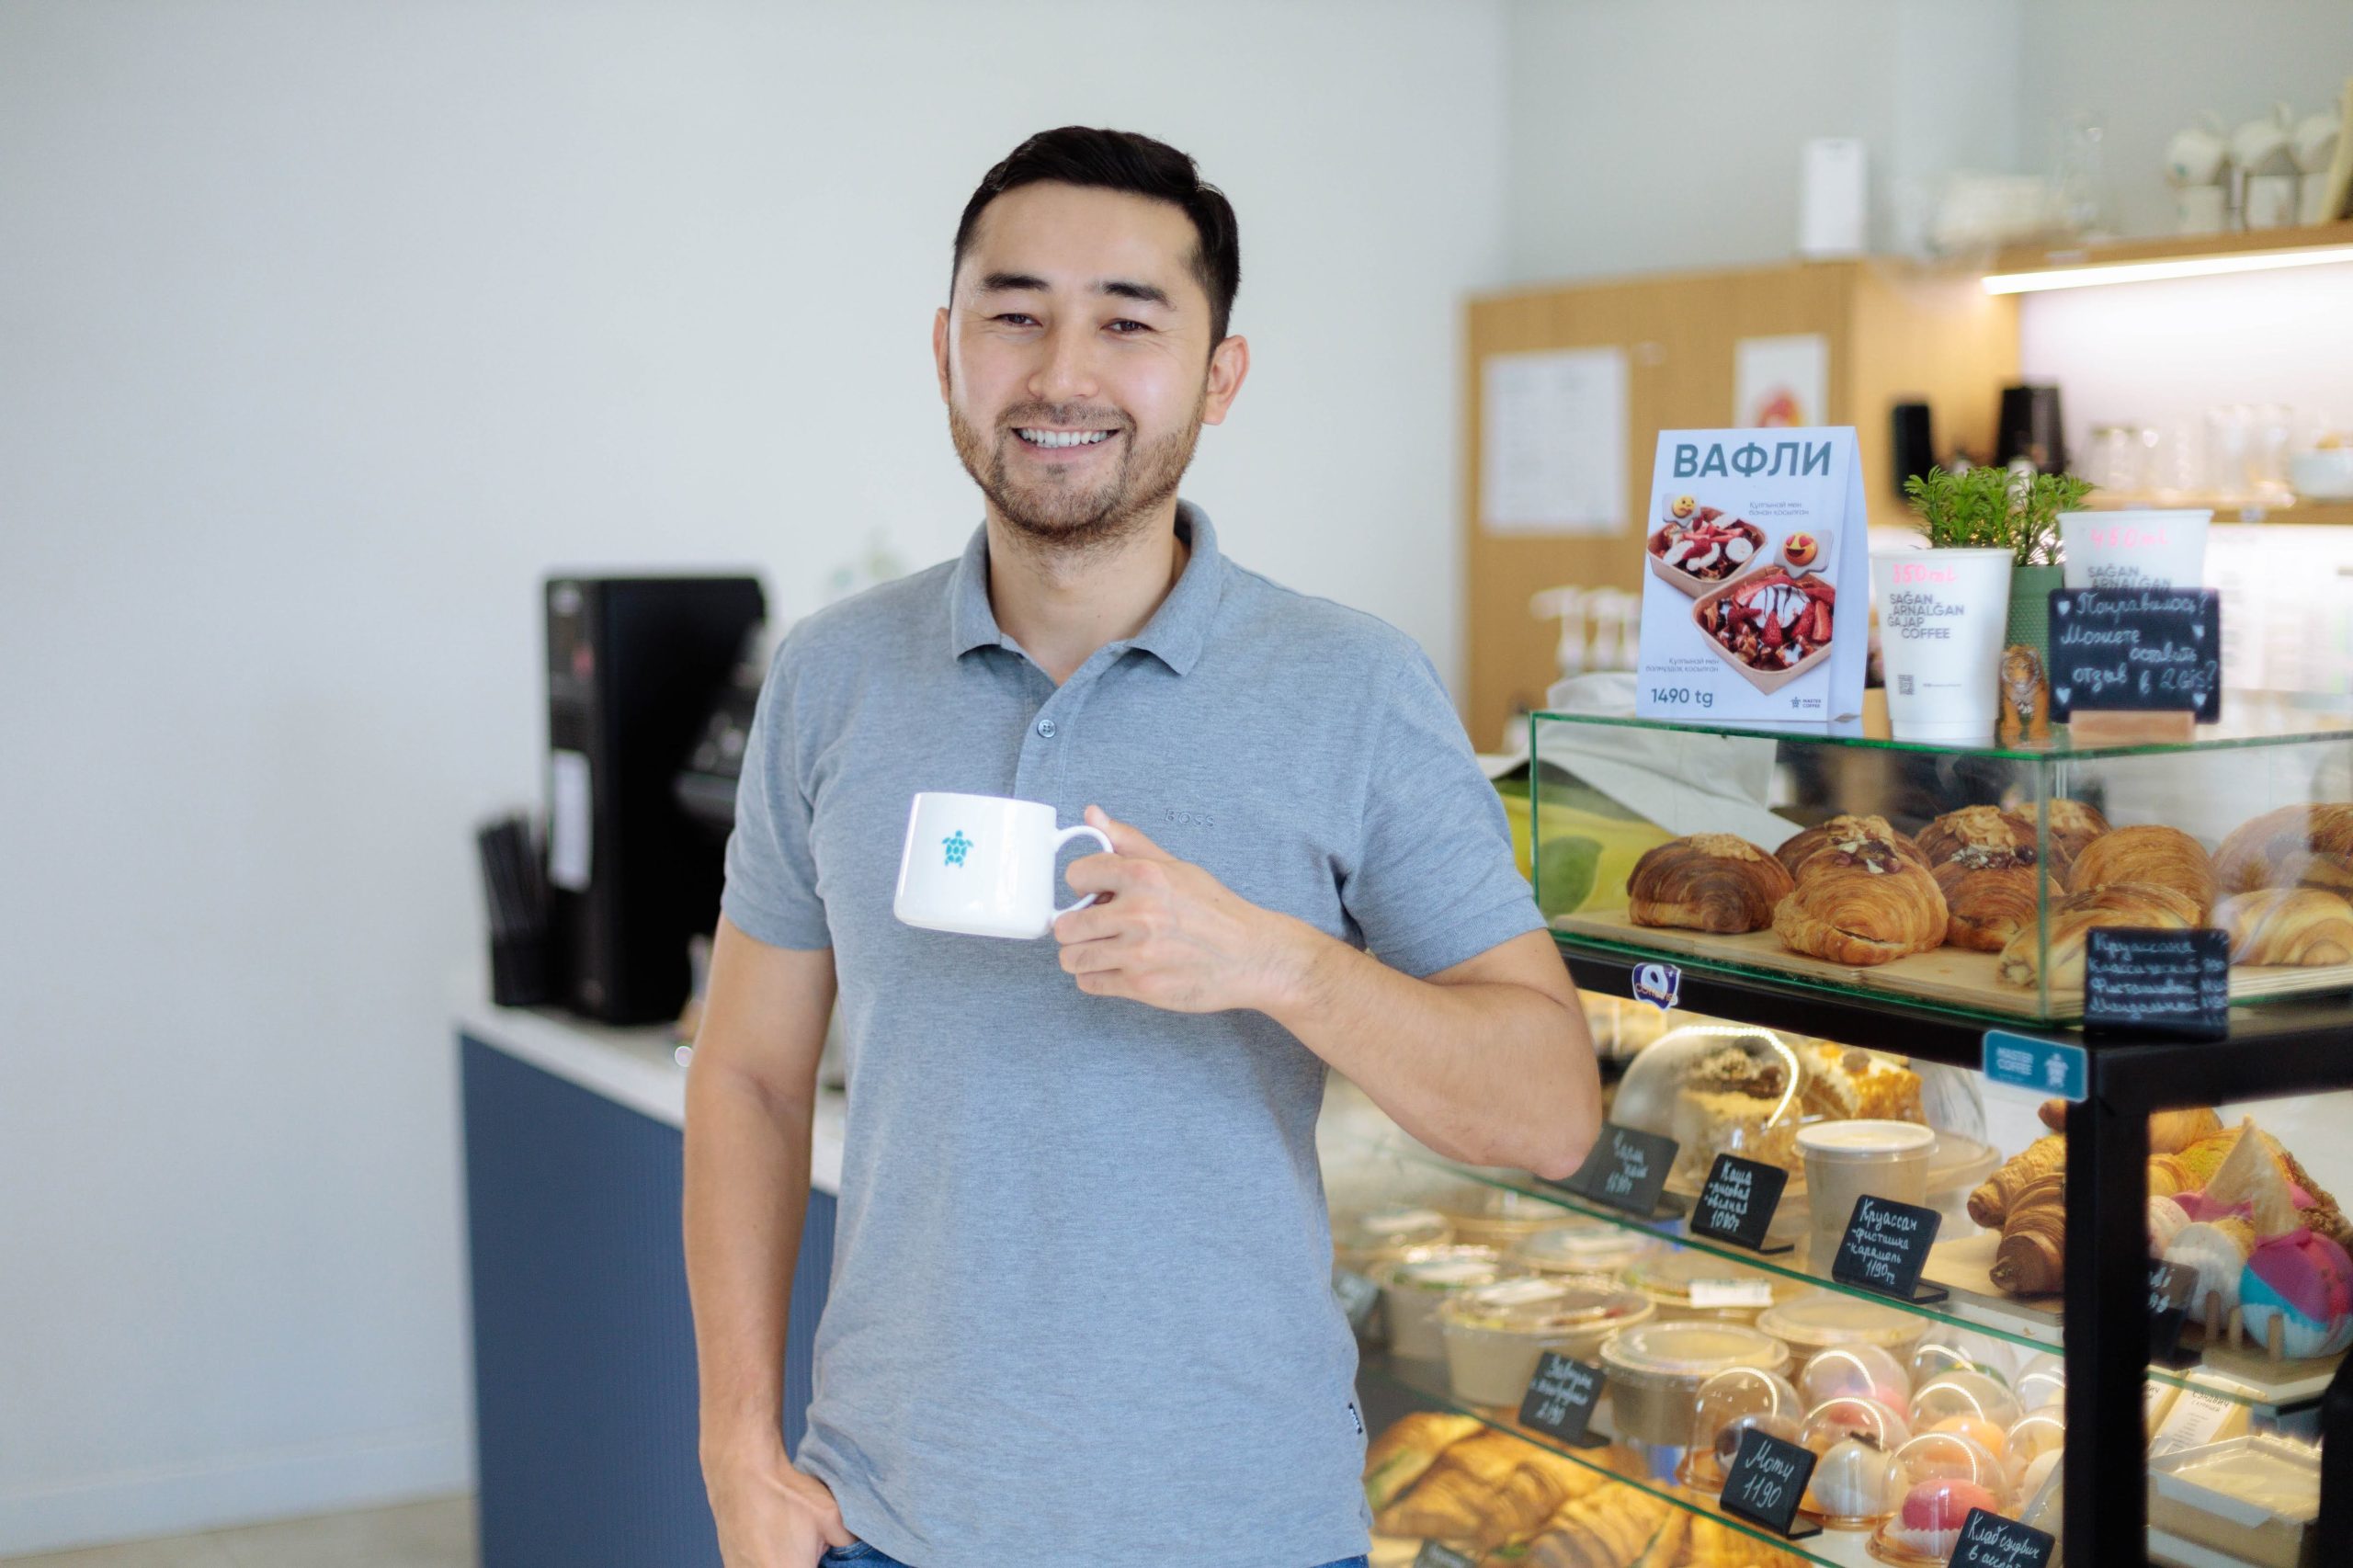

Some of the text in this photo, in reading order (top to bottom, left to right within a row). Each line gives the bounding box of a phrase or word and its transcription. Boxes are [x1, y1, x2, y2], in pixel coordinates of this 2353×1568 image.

[1673, 441, 1832, 478] ВАФЛИ
[1902, 628, 1949, 639] COFFEE
[2061, 623, 2141, 644] Можете
[1652, 688, 1713, 708] 1490 tg
[1165, 809, 1215, 828] BOSS
[1721, 1160, 1752, 1186] Каша
[1859, 1199, 1917, 1231] Круассан
[1743, 1474, 1782, 1508] 1190
